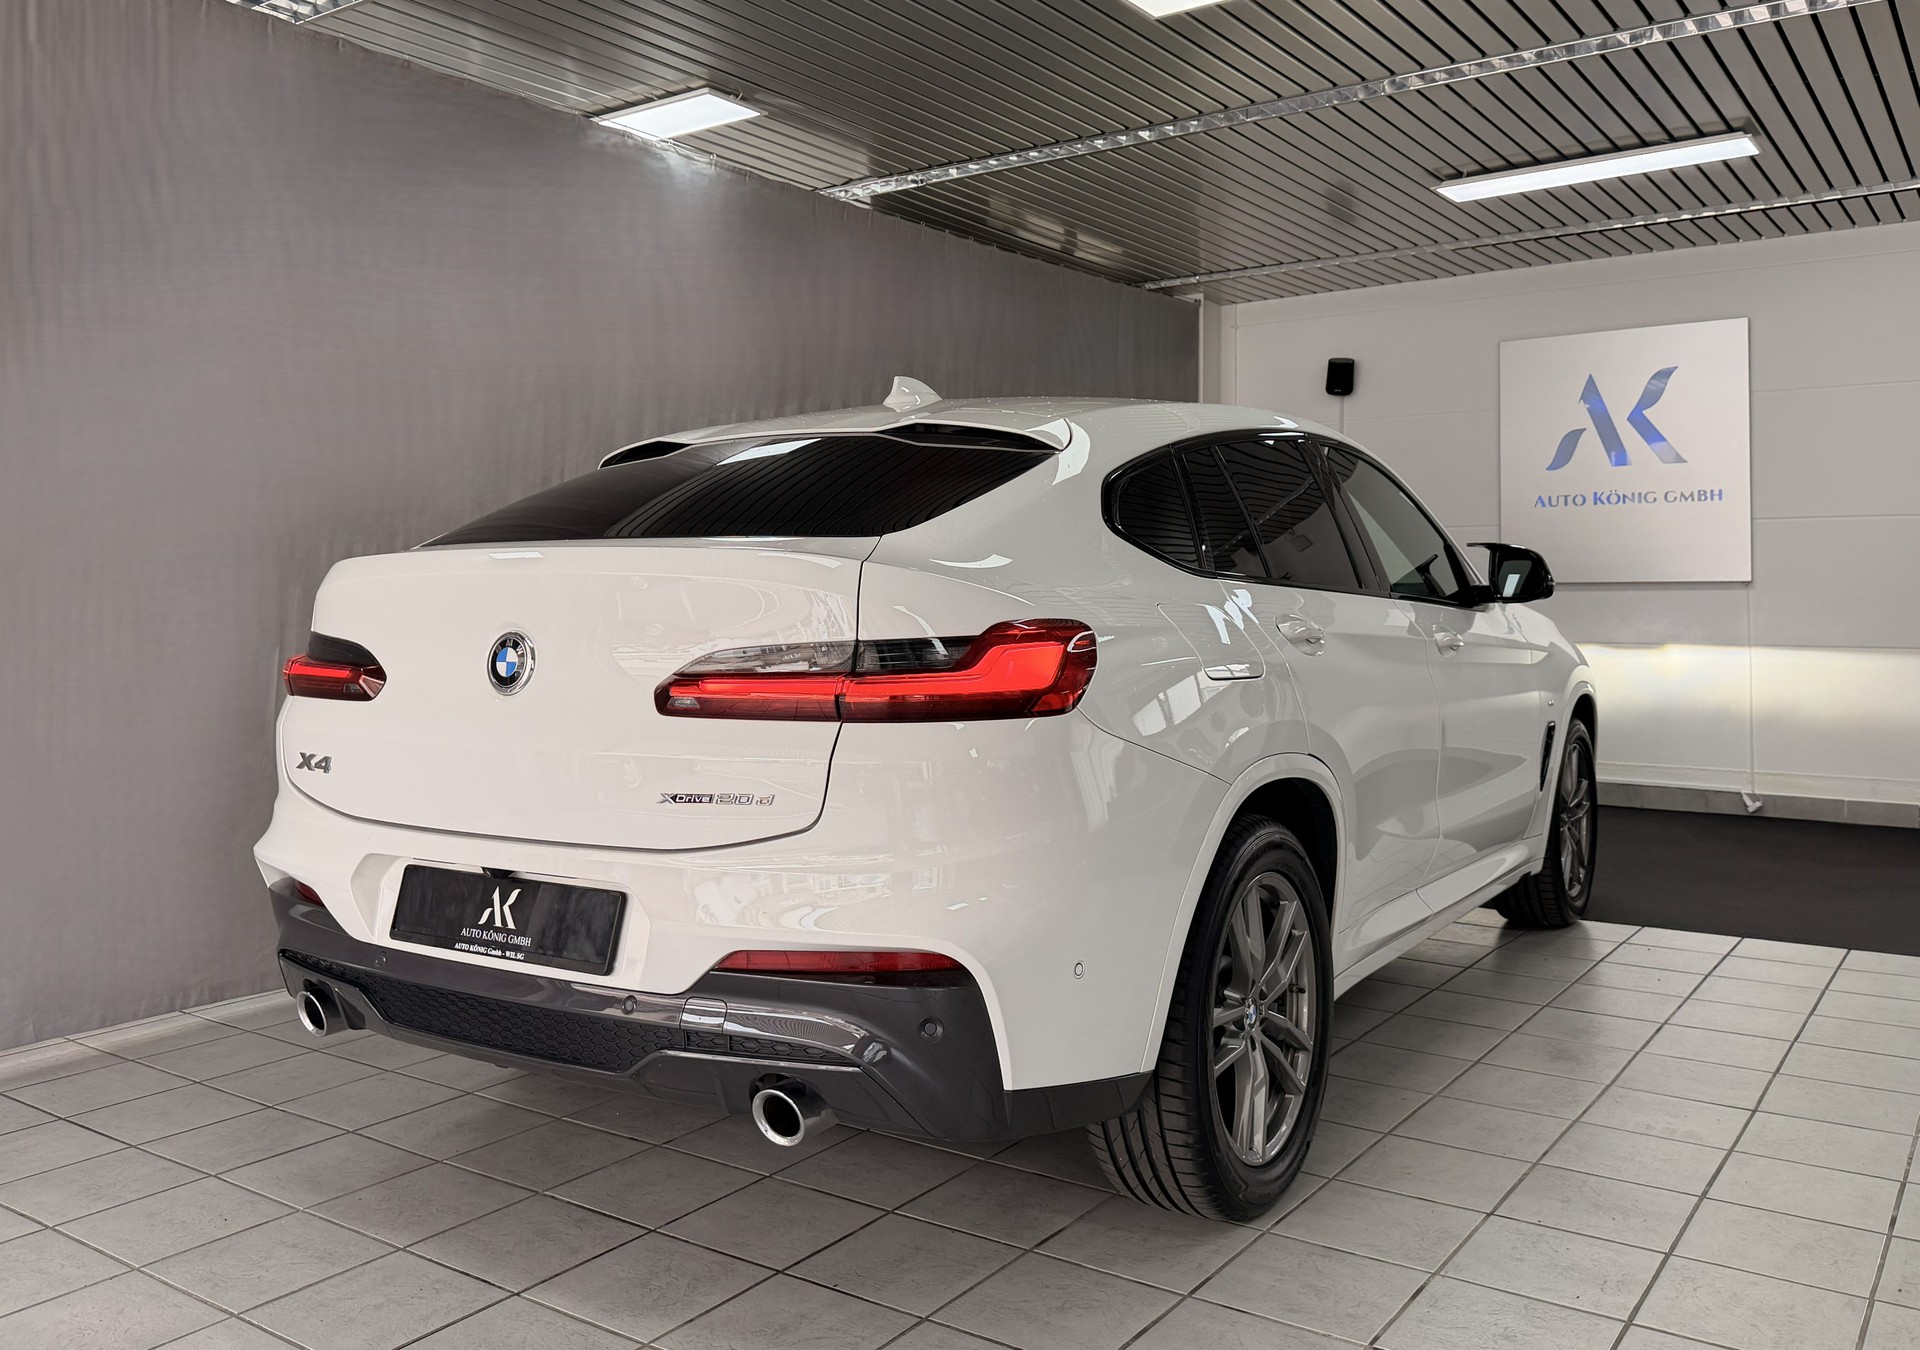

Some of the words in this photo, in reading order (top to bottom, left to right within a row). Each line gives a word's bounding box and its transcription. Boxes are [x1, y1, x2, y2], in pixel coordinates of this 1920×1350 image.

[1534, 494, 1587, 508] AUTO
[1592, 489, 1657, 506] KÖNIG
[1663, 488, 1724, 503] GMBH
[296, 751, 332, 774] X4
[478, 886, 521, 929] AK
[461, 927, 482, 938] AUTO
[482, 930, 507, 942] KÖNIG
[508, 935, 531, 946] GMBH
[454, 942, 469, 950] AUTO
[469, 943, 488, 953] KÖNIG
